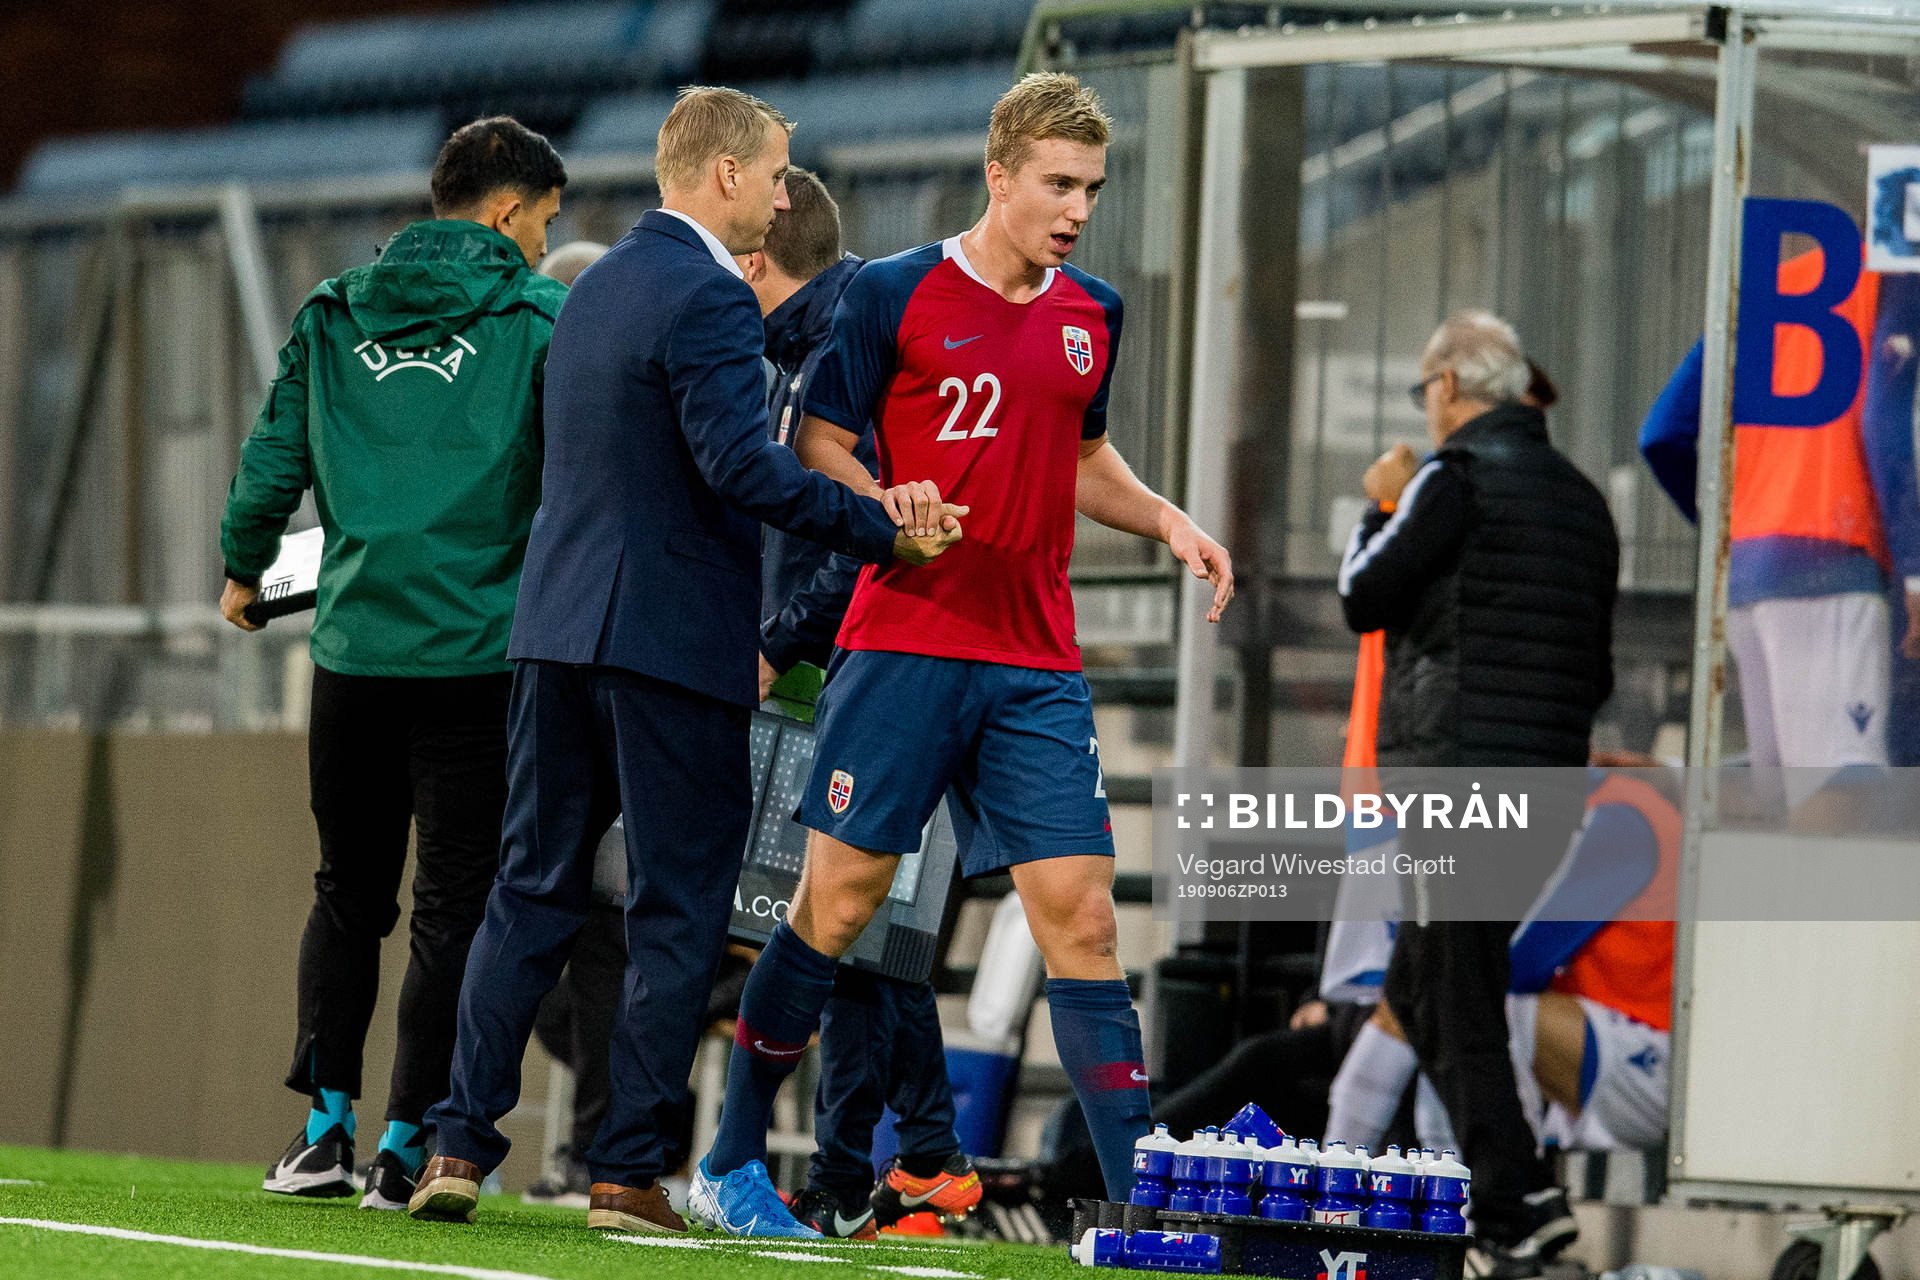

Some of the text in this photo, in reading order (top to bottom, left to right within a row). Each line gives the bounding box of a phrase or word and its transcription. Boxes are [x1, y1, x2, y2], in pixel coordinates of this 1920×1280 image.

[1733, 196, 1862, 428] B
[936, 372, 1001, 441] 22
[1371, 1174, 1393, 1192] YT
[1319, 1248, 1368, 1280] YT
